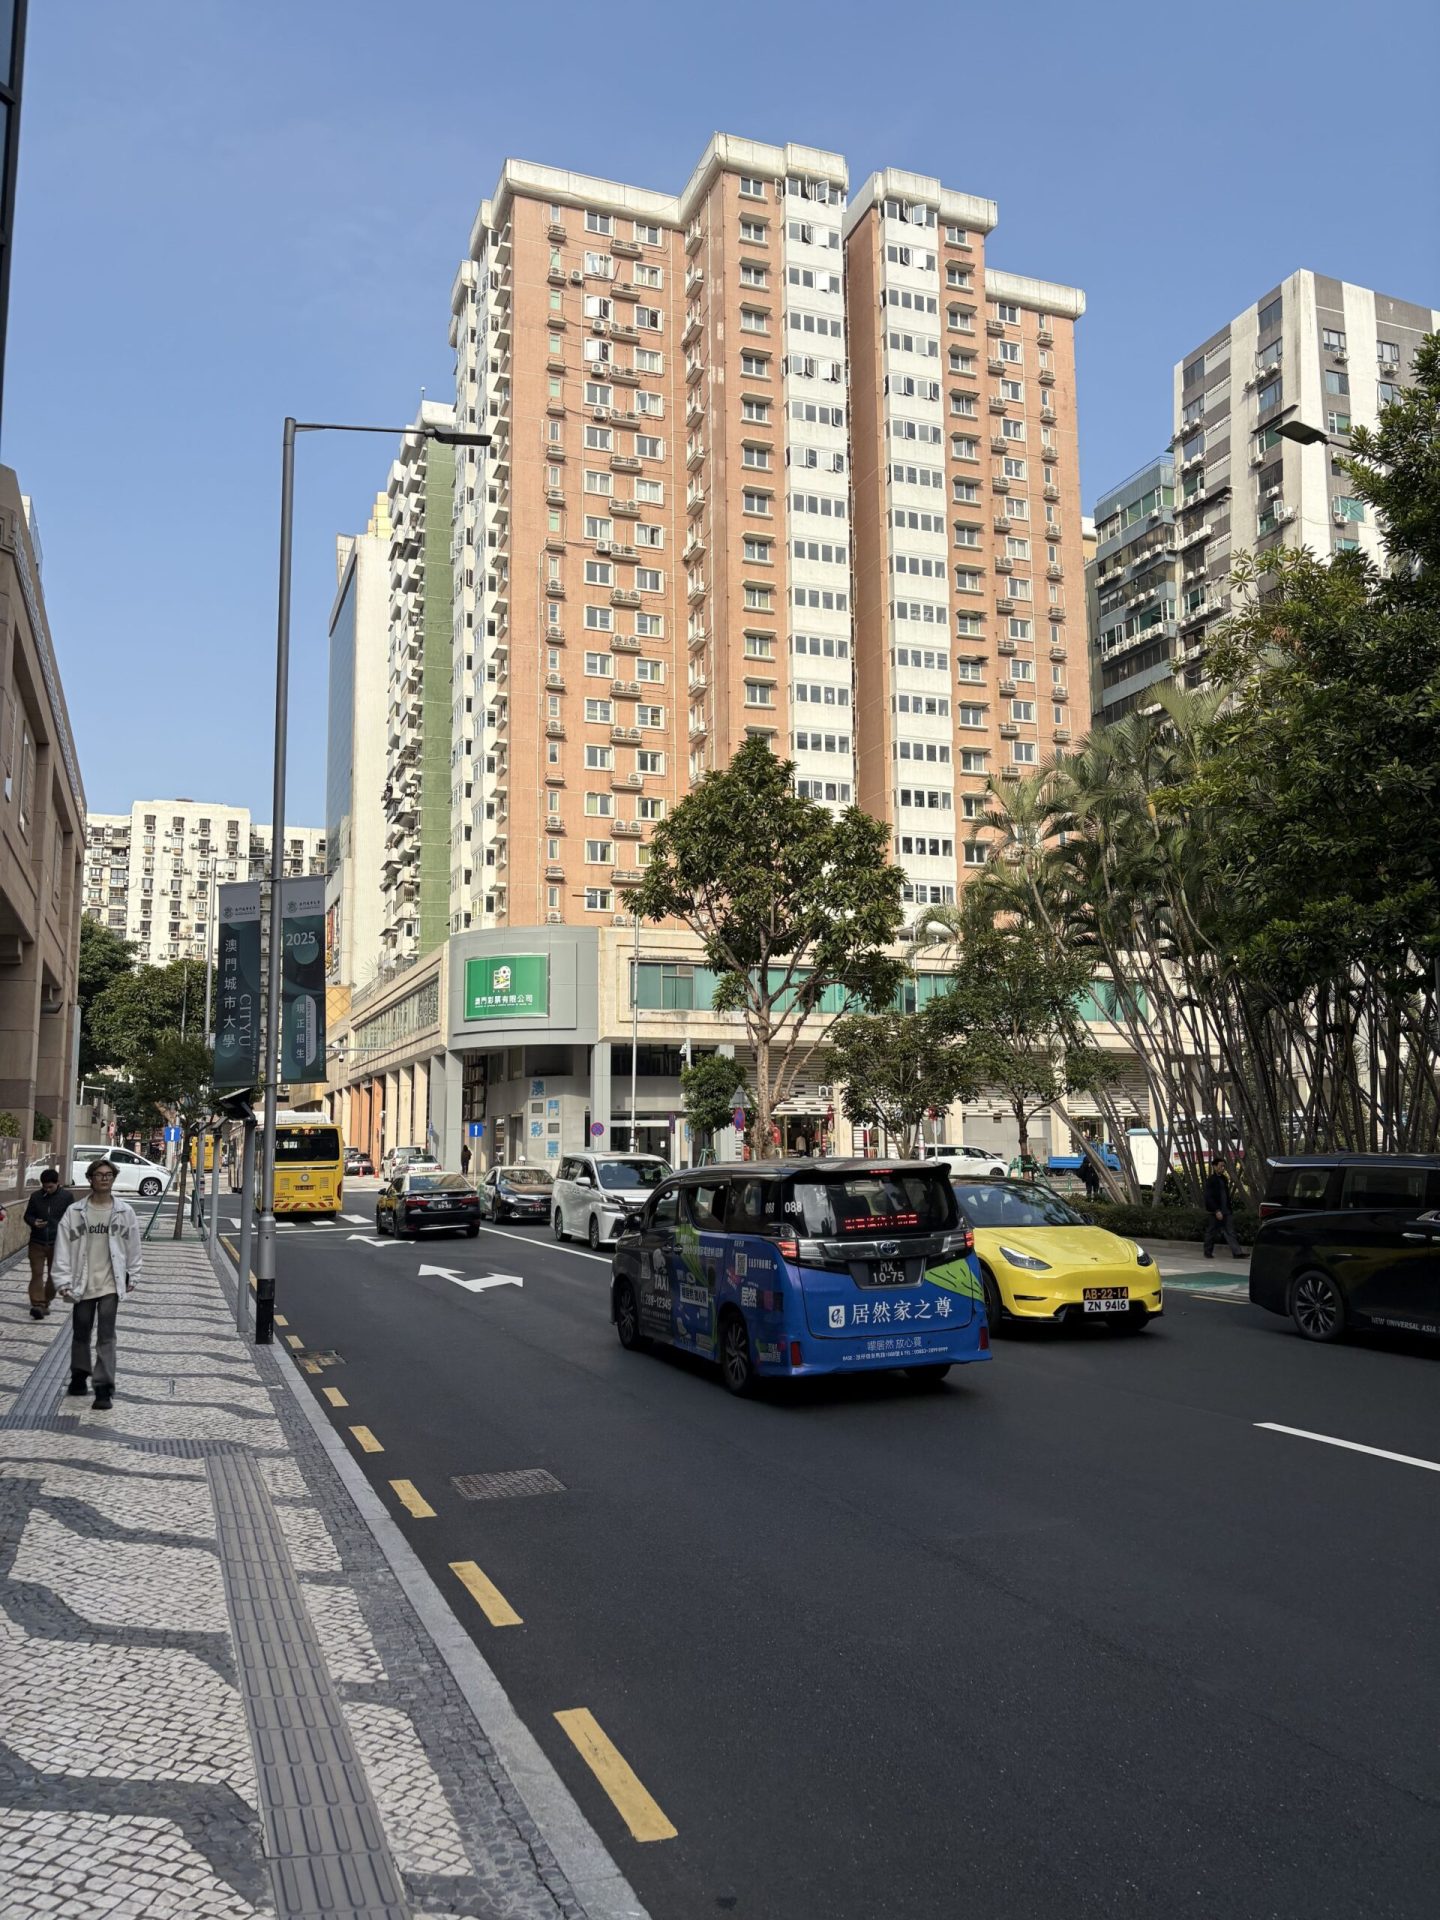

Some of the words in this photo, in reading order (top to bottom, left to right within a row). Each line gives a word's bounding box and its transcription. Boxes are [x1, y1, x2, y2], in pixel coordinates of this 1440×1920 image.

[286, 932, 316, 946] 2025
[223, 939, 237, 1047] 澳門城市大學
[239, 993, 252, 1047] CITYU
[296, 1003, 305, 1059] 現正招生
[784, 1201, 803, 1213] 088
[880, 1261, 894, 1272] MX
[654, 1274, 670, 1292] TAXI
[873, 1272, 905, 1283] 10-75
[1084, 1288, 1127, 1300] AB-22-14
[851, 1297, 953, 1325] 居然家之尊
[1087, 1301, 1101, 1311] ZN
[1104, 1300, 1127, 1310] 9416
[1371, 1316, 1385, 1325] NEW
[1386, 1319, 1420, 1331] UNIVERSAL
